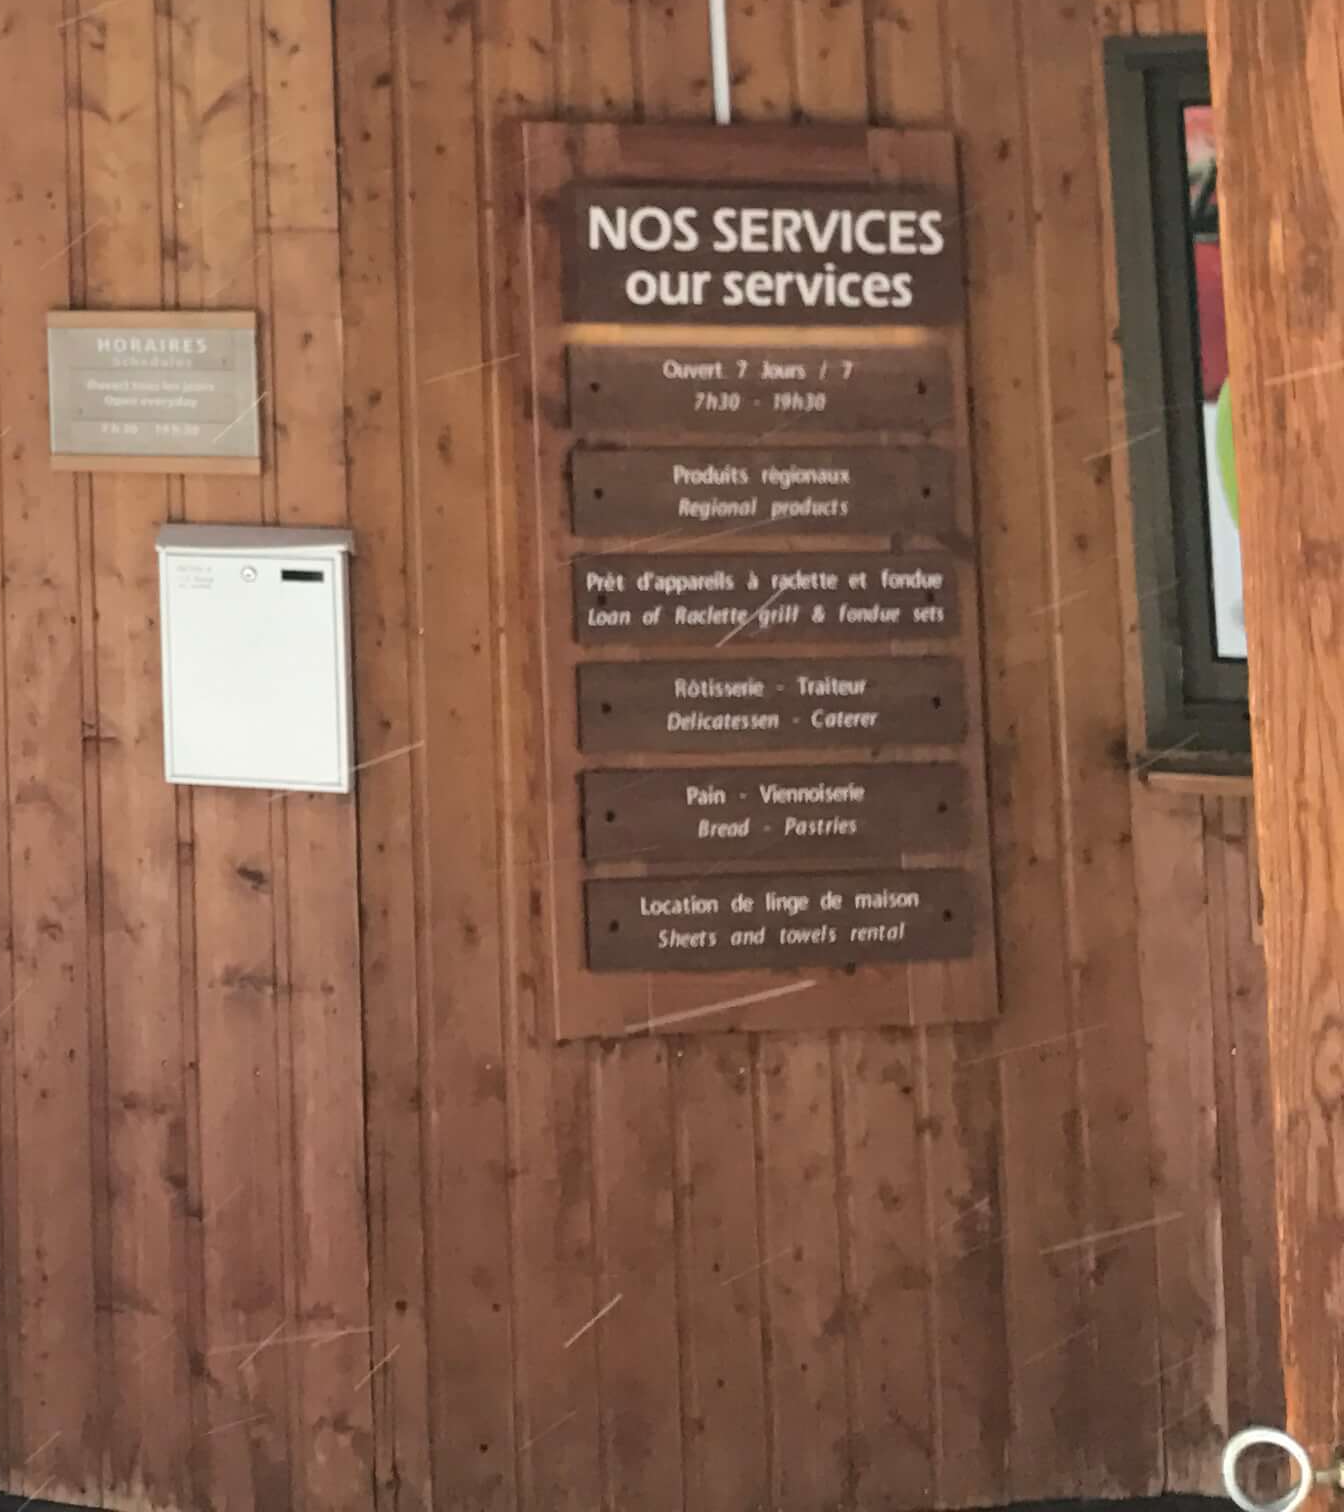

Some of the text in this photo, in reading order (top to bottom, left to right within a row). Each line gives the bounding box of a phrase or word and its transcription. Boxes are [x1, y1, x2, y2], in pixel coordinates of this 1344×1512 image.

[588, 206, 944, 255] NOS SERVICES
[626, 262, 914, 308] our services
[97, 338, 208, 354] HORAIRES
[663, 359, 722, 381] Ouvert
[735, 360, 747, 381] 7
[842, 361, 854, 381] 7
[695, 393, 740, 411] 7h30
[773, 394, 826, 411] 19h30
[673, 464, 850, 490] Produits régionaux
[678, 498, 849, 521] Regional products
[586, 569, 943, 596] Prêt d'appareils à raclette et fondue
[587, 604, 944, 629] Loan of Raclette grill & fondue sets
[674, 675, 764, 699] Rôtisserie
[797, 675, 867, 696] Traiteur
[667, 710, 779, 731] Delicatessen
[811, 709, 880, 729] Caterer
[686, 784, 726, 805] Pain
[759, 782, 866, 804] Viennoiserie
[698, 818, 750, 838] Bread
[784, 816, 857, 836] Pastries
[640, 889, 919, 916] Location de linge de maison
[658, 922, 905, 949] Sheets and towels rental
